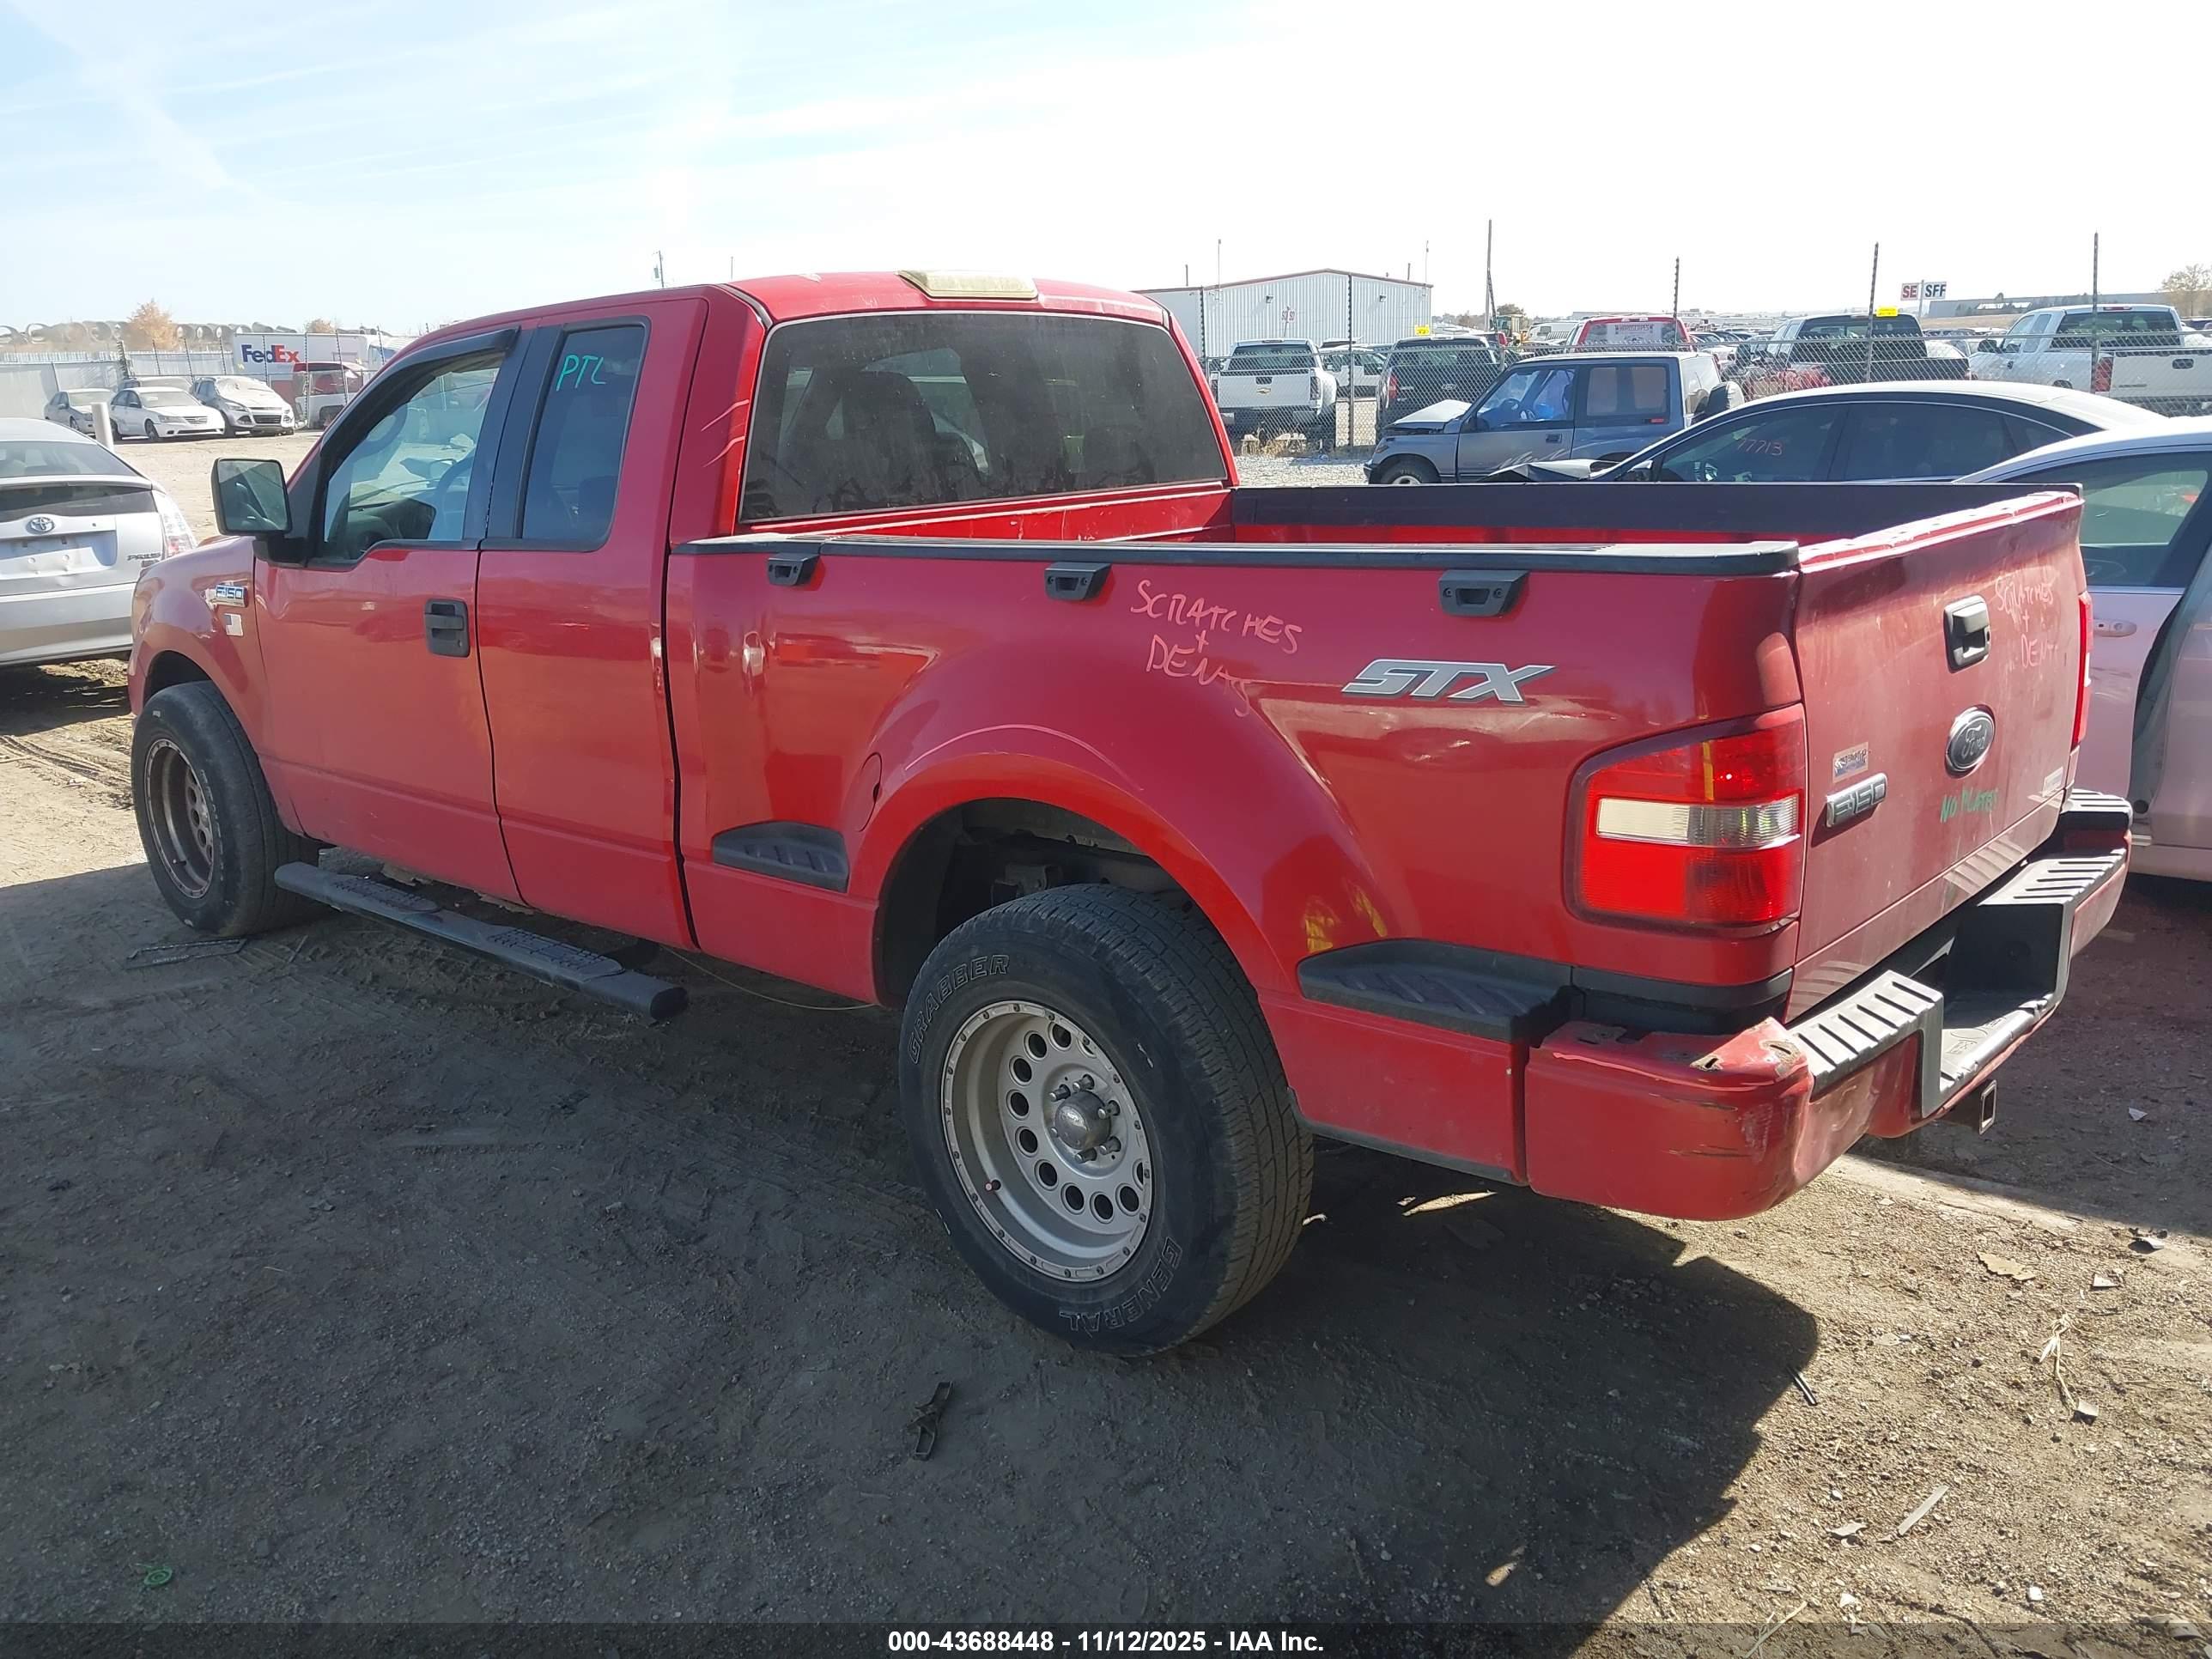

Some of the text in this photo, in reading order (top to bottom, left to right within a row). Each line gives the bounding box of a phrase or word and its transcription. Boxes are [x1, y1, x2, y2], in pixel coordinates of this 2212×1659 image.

[1902, 285, 1917, 298] SE
[241, 344, 300, 363] FedEx
[1130, 580, 1303, 654] SCRATCHES
[1341, 659, 1555, 702] STX
[1961, 725, 1988, 759] Ford
[1940, 794, 1957, 823] NO
[908, 954, 1009, 1064] GRABBER
[1059, 1236, 1182, 1332] GENERAL
